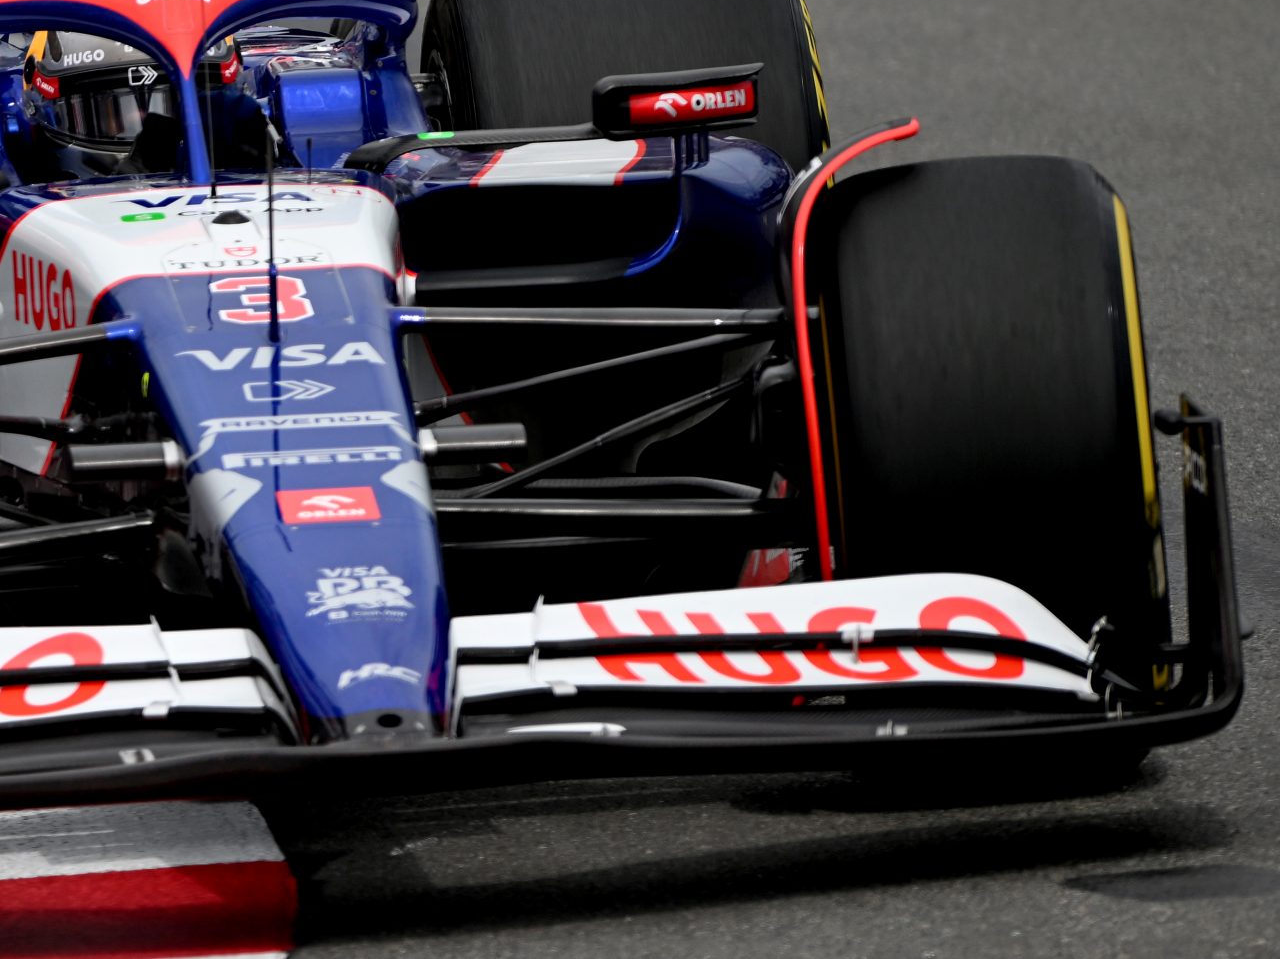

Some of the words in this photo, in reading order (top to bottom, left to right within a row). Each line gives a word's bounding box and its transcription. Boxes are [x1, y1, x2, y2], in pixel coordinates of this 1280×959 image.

[63, 49, 105, 67] HUGO
[690, 89, 746, 111] ORLEN
[111, 191, 314, 208] VISA
[170, 255, 322, 270] TUDOR
[11, 249, 77, 331] HUGO
[208, 275, 315, 325] 3
[175, 341, 387, 371] VISA
[220, 415, 384, 429] RAVENOL
[221, 446, 403, 469] PIRELLI
[297, 508, 367, 519] ORLEN
[318, 565, 390, 577] VISA
[577, 597, 1026, 684] HUGO
